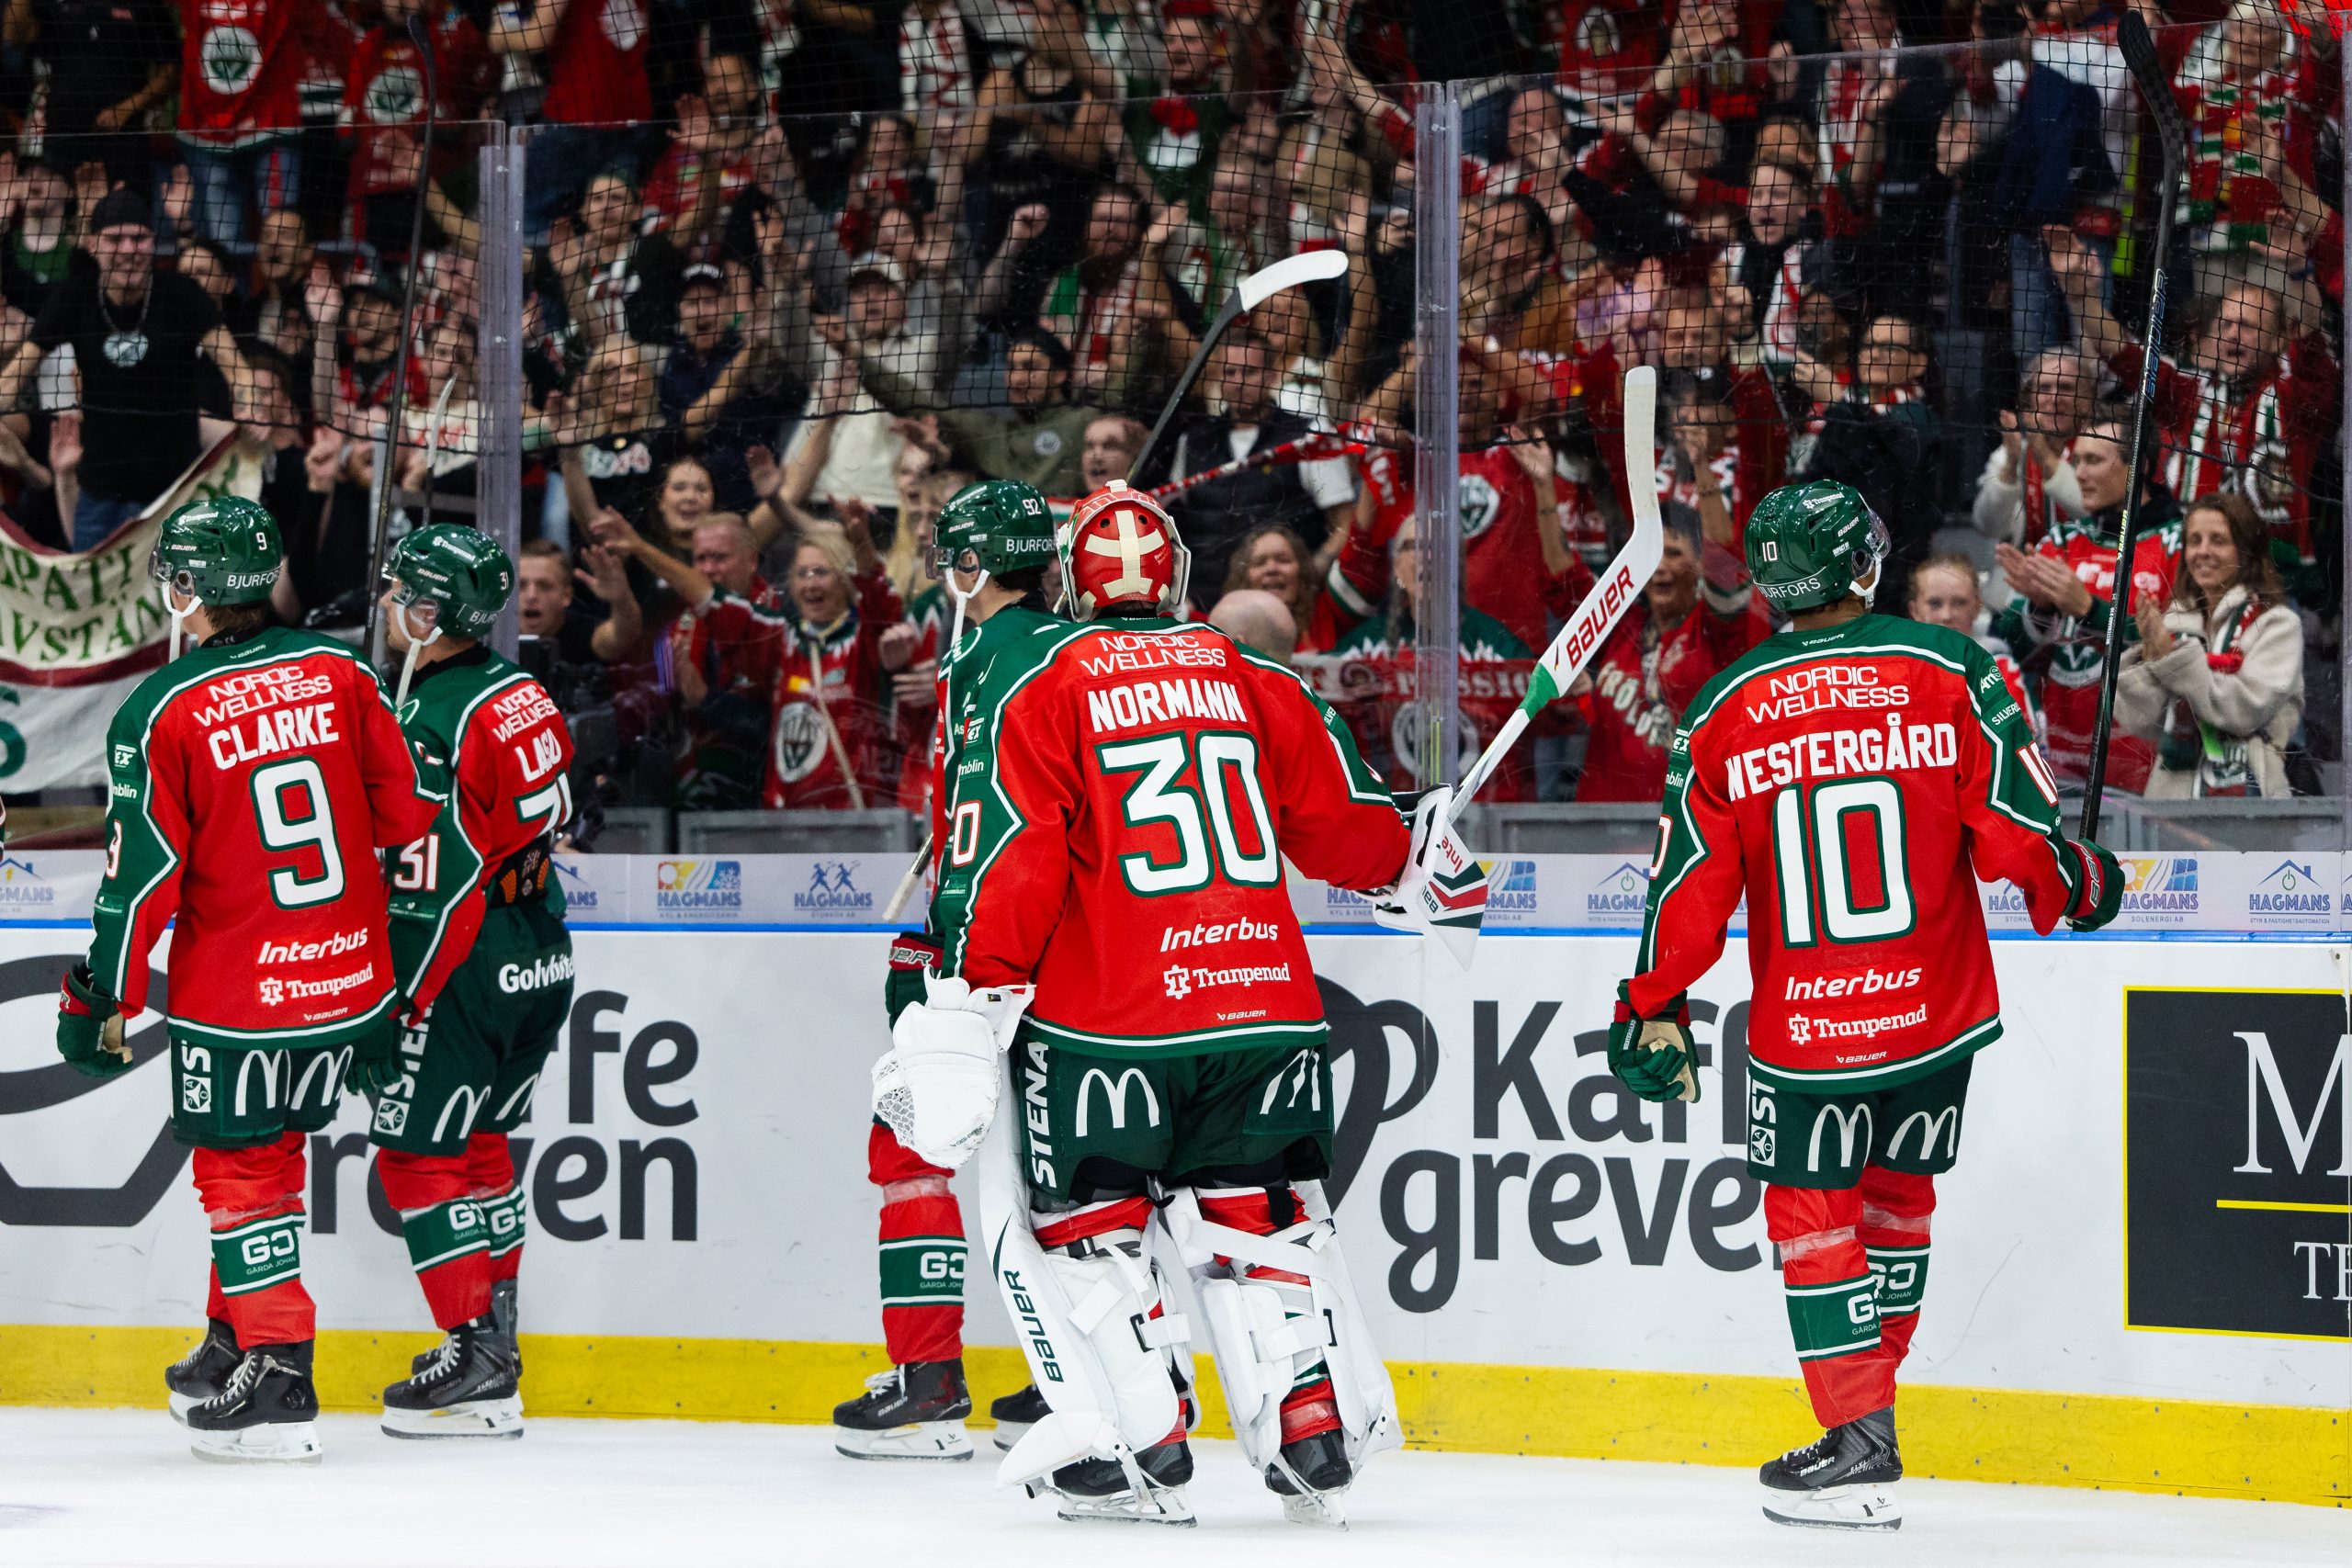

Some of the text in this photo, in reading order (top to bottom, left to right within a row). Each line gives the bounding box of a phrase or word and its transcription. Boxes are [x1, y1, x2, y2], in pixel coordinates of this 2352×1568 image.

[1023, 499, 1042, 516] 92
[255, 532, 267, 551] 9
[1838, 516, 1860, 537] BAUER
[171, 544, 198, 552] BAUER
[1762, 541, 1778, 562] 10
[1566, 564, 1634, 671] BAUER
[1098, 634, 1200, 652] NORDIC
[1080, 648, 1227, 677] WELLNESS
[208, 665, 305, 703] NORDIC
[1769, 666, 1879, 698] NORDIC
[192, 674, 334, 728] WELLNESS
[1087, 678, 1249, 733] NORMANN
[1747, 684, 1910, 724] WELLNESS
[209, 702, 340, 771] CLARKE
[1096, 732, 1280, 897] 30
[251, 756, 345, 908] 9
[1774, 777, 1916, 947] 10
[657, 891, 742, 908] HAGMANS
[794, 892, 873, 907] HAGMANS
[1988, 895, 2024, 910] HAG
[2249, 894, 2332, 911] HAGMANS
[257, 927, 369, 965] Interbus
[1160, 916, 1279, 953] Interbus
[286, 962, 375, 999] Tranpenad
[1192, 962, 1291, 989] Tranpenad
[1784, 966, 1923, 1001] Interbus
[312, 1007, 349, 1021] BAUER
[1227, 1010, 1267, 1021] BAUER
[1813, 1002, 1928, 1038] Tranpenad
[181, 1040, 212, 1073] S
[520, 989, 700, 1128] fe
[1845, 1051, 1887, 1065] BAUER
[1025, 1041, 1057, 1189] STENA
[1380, 1150, 1782, 1314] greve
[1003, 1269, 1065, 1383] BAUER
[1799, 1455, 1836, 1477] BAUER
